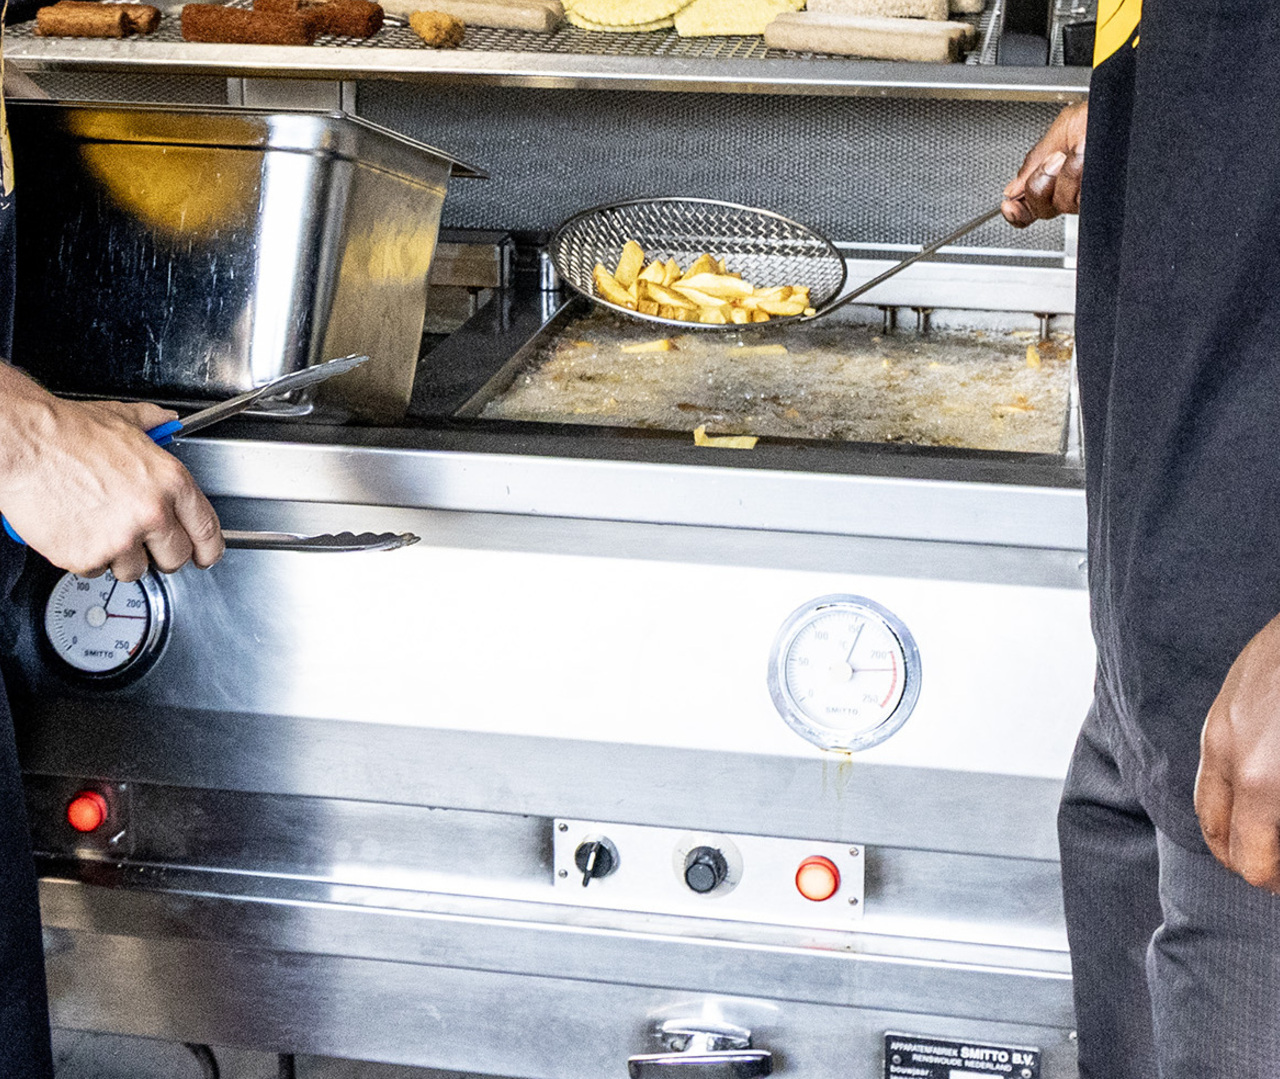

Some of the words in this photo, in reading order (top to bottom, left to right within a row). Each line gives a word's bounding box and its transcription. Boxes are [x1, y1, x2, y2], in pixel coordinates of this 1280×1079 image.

[77, 582, 90, 591] 100
[126, 599, 141, 608] 200
[63, 607, 73, 618] 50
[72, 635, 78, 645] 0
[814, 631, 829, 640] 100
[114, 639, 129, 649] 250
[84, 650, 114, 659] SMITTO
[871, 650, 887, 660] 200
[798, 657, 810, 666] 50
[826, 707, 858, 715] SMITTO
[960, 1047, 1009, 1062] SMITTO
[1012, 1052, 1035, 1067] B.V.
[912, 1054, 963, 1066] RENSWOUDE
[964, 1060, 1013, 1072] NEDERLAND
